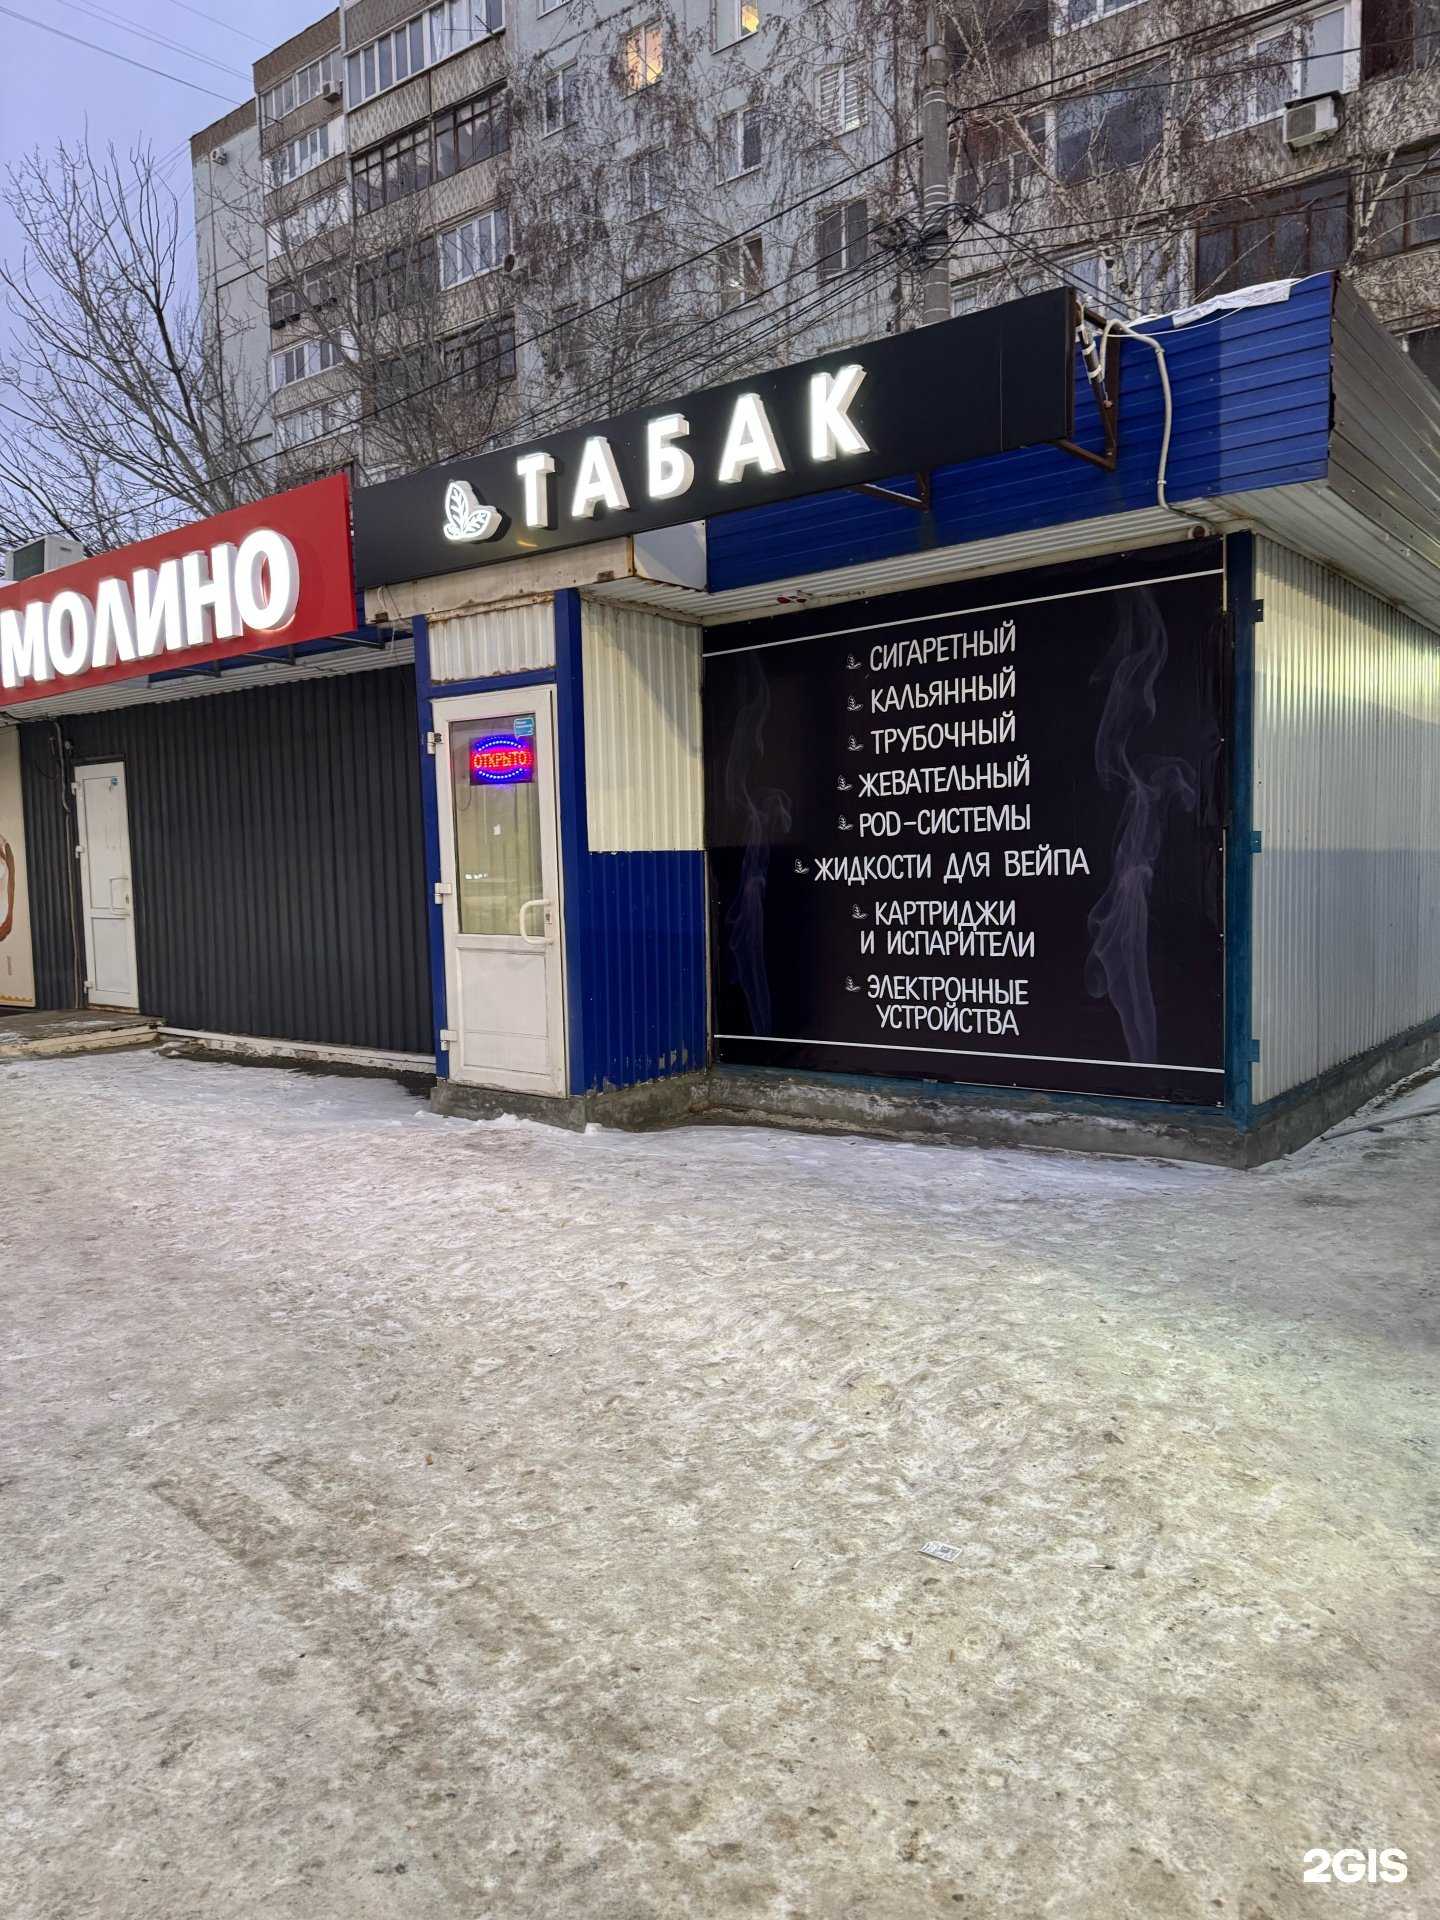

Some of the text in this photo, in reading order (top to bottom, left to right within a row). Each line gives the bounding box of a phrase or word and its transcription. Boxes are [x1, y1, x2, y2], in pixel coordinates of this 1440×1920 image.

[517, 364, 871, 528] ТАБАК
[0, 528, 300, 689] МОЛИНО
[869, 620, 1016, 672] СИГАРЕТНЫЙ
[871, 665, 1016, 713] КАЛЬЯННЫЙ
[871, 710, 1016, 755] ТРУБОЧНЫЙ
[473, 751, 531, 768] ОТКРЫТО
[858, 754, 1030, 798] ЖЕВАТЕЛЬНЫЙ
[859, 804, 1031, 837] POD-СИСТЕМЫ
[814, 843, 1090, 885] ЖИДКОСТИ ДЛЯ ВЕЙПА
[875, 900, 1016, 930] КАРТРИДЖИ
[860, 931, 1035, 957] И ИСПАРИТЕЛИ
[867, 975, 1029, 1005] ЭЛЕКТРОННЫЕ
[876, 1001, 1019, 1036] УСТРОЙСТВА
